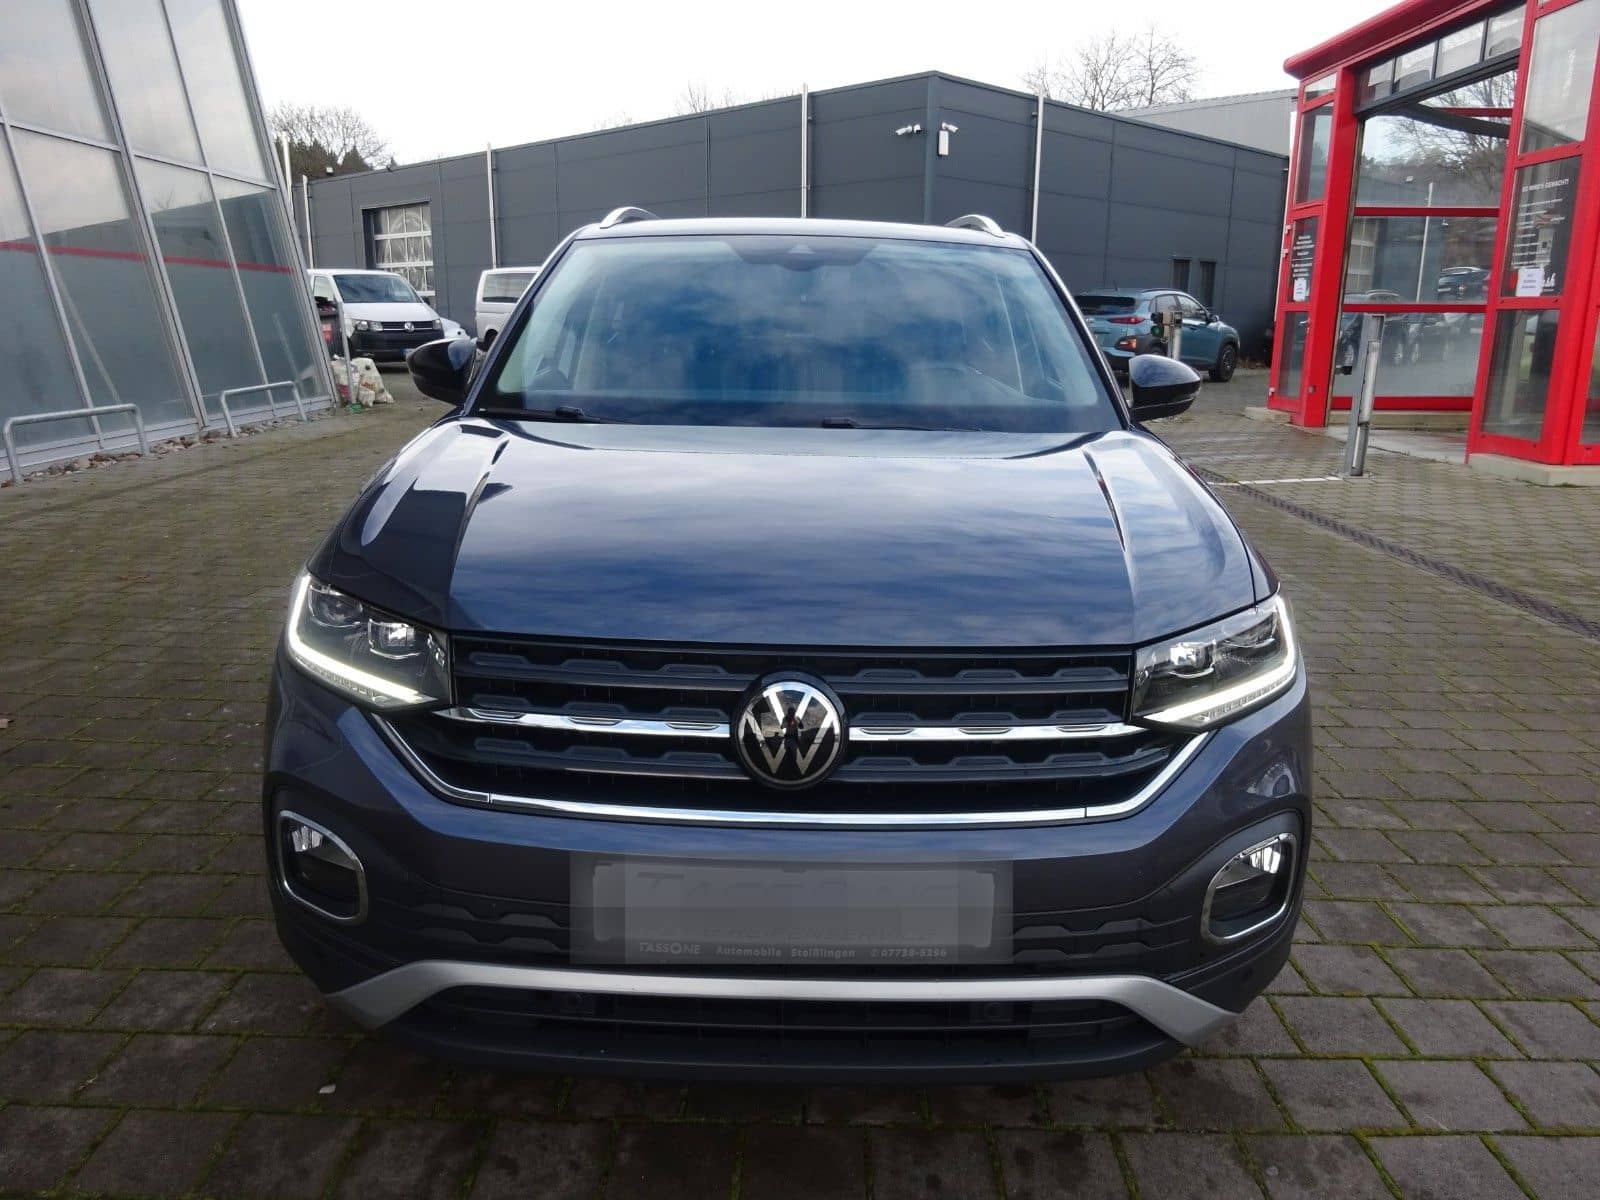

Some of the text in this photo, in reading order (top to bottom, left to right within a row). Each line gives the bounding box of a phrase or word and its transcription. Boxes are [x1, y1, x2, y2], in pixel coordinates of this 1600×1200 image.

[739, 683, 840, 780] VW
[639, 942, 701, 955] TASSONE
[715, 945, 782, 957] Automobile
